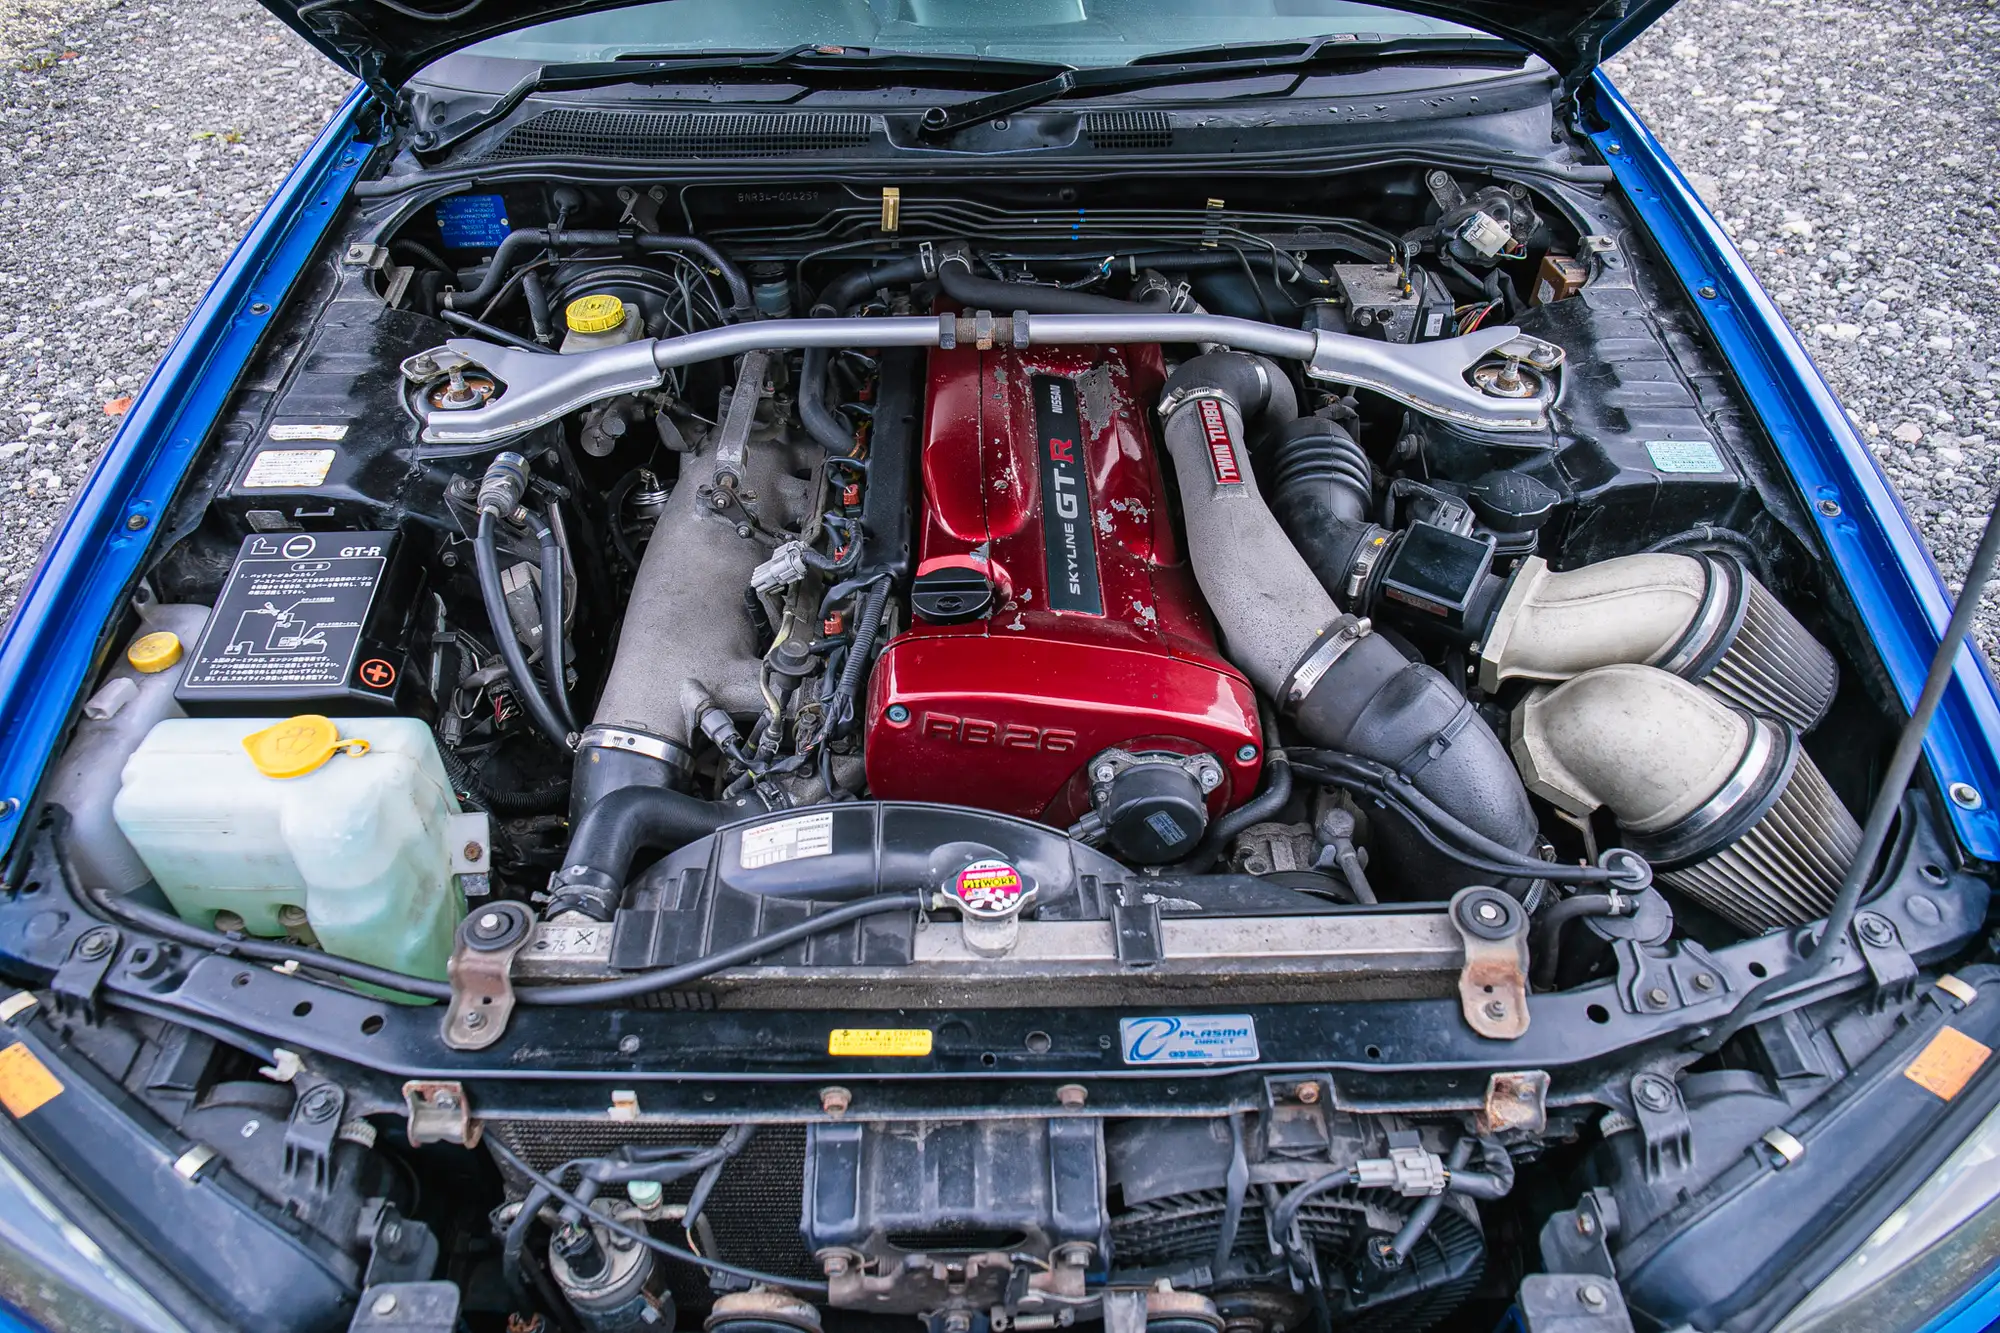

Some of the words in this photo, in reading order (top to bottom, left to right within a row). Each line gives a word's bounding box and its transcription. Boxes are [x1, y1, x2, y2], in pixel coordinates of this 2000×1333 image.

[1050, 384, 1063, 414] NISSAN
[1201, 400, 1227, 442] TURBO
[1212, 444, 1238, 480] TWIN
[340, 546, 382, 557] GT-R
[1064, 523, 1081, 596] SKYLINE
[921, 710, 1078, 752] RB26
[1179, 1027, 1248, 1039] PLASMA
